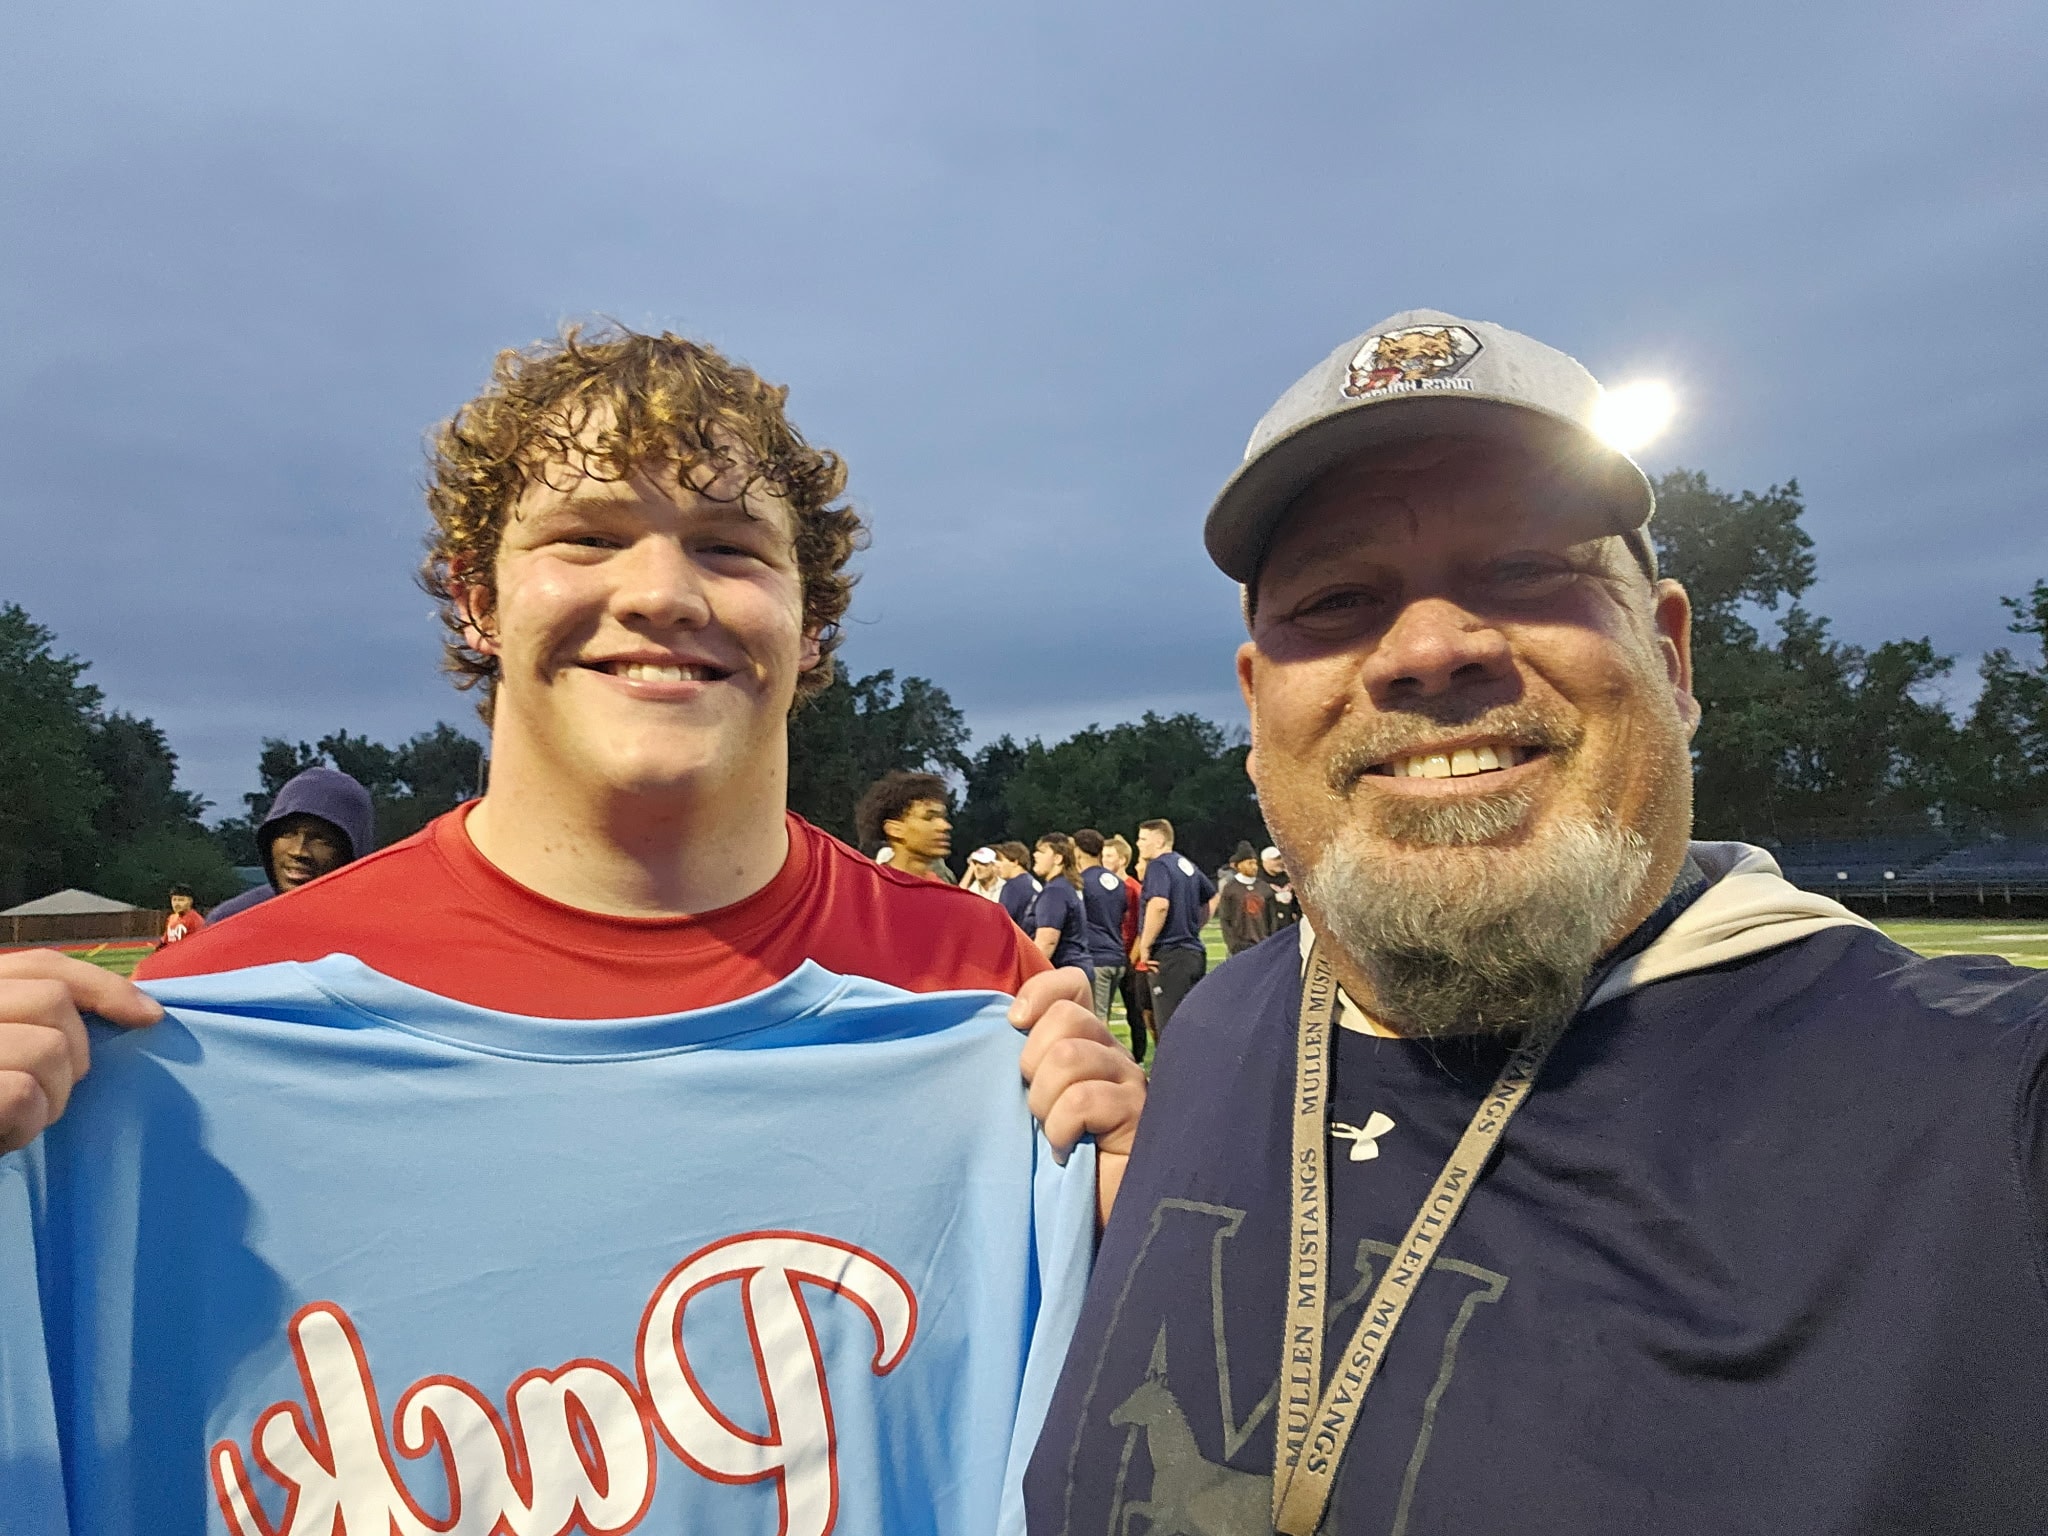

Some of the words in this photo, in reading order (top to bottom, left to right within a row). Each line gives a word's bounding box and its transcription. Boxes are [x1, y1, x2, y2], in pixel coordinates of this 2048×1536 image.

[1301, 1021, 1323, 1115] MULLEN
[1298, 1147, 1319, 1309] MUSTANGS
[1392, 1165, 1468, 1288] MULLEN
[1287, 1325, 1314, 1468] MULLEN
[1307, 1299, 1396, 1476] MUSTANGS
